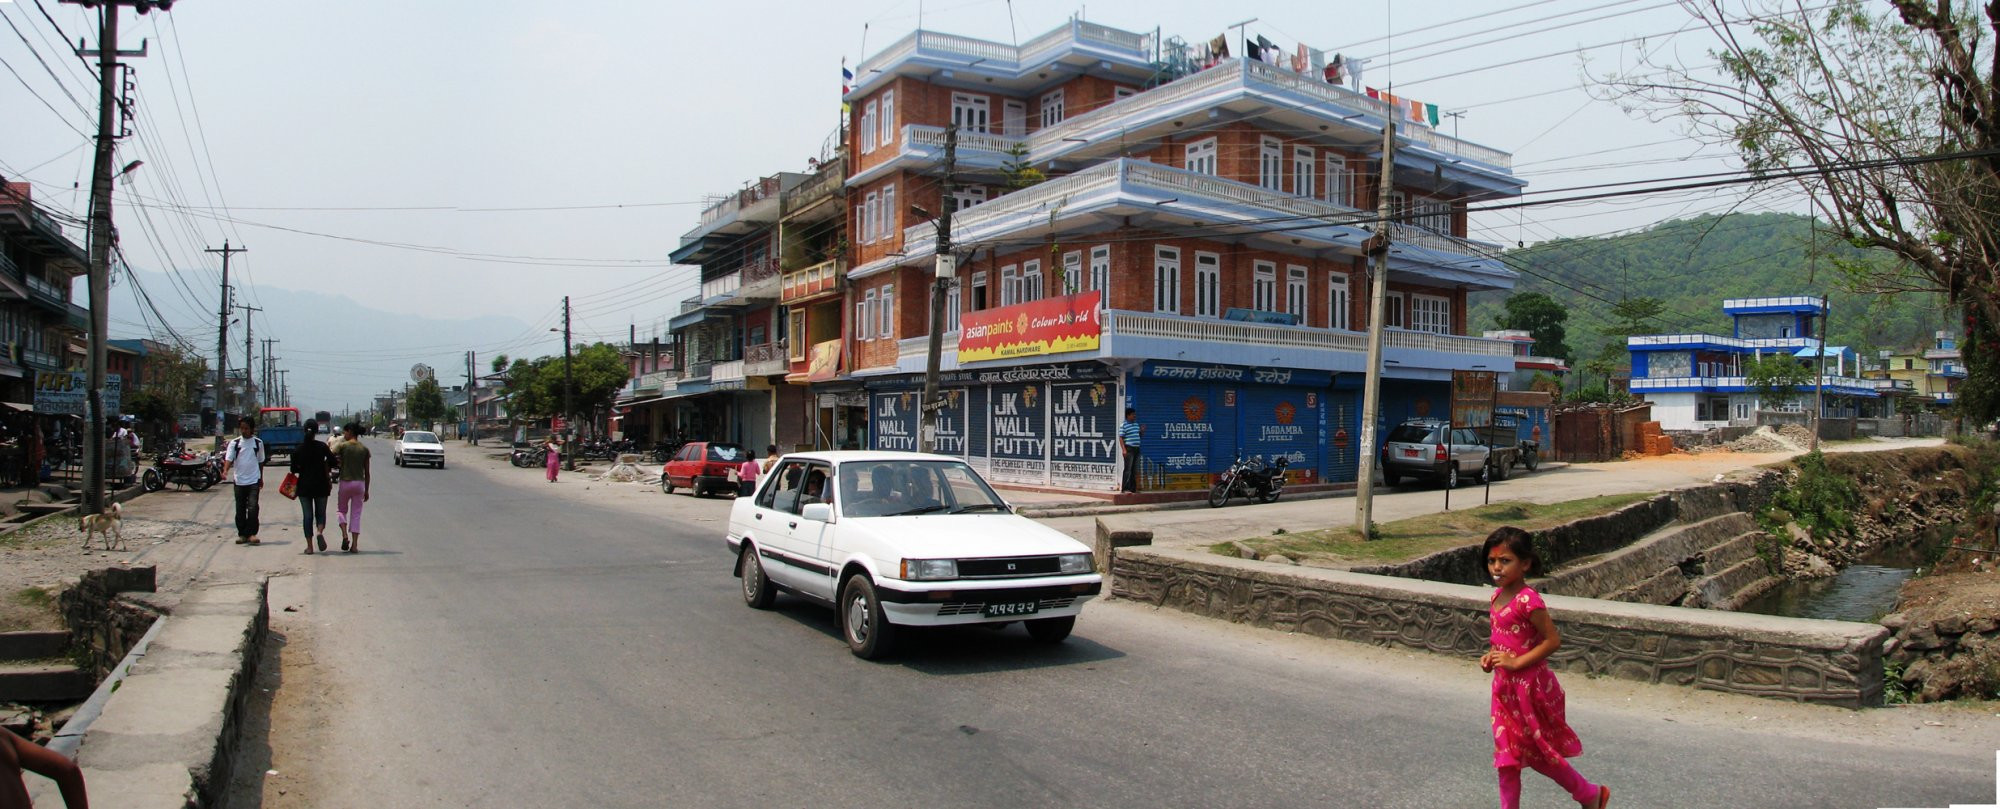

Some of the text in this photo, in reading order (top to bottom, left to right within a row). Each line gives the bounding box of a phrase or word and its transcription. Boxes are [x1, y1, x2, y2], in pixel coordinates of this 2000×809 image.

[966, 309, 1089, 343] asianpaints Colour World
[1001, 345, 1041, 356] KAMAL HARDWARE
[979, 371, 1002, 383] कमल
[1153, 365, 1196, 378] कमल
[879, 397, 896, 417] JK
[994, 392, 1018, 416] JK
[1054, 389, 1081, 414] JK
[879, 420, 908, 435] WALL
[994, 416, 1035, 437] WALL
[1054, 415, 1103, 438] WALL
[1161, 422, 1213, 439] JAGDAMBA
[1258, 425, 1303, 442] JAGDAMBA
[879, 436, 914, 450] PUTTY
[994, 437, 1045, 455] PUTTY
[1054, 439, 1115, 458] PUTTY
[1001, 459, 1024, 468] PERFECT
[1026, 461, 1045, 470] PUTTY
[1050, 462, 1115, 474] THE PERFECT PUTTY
